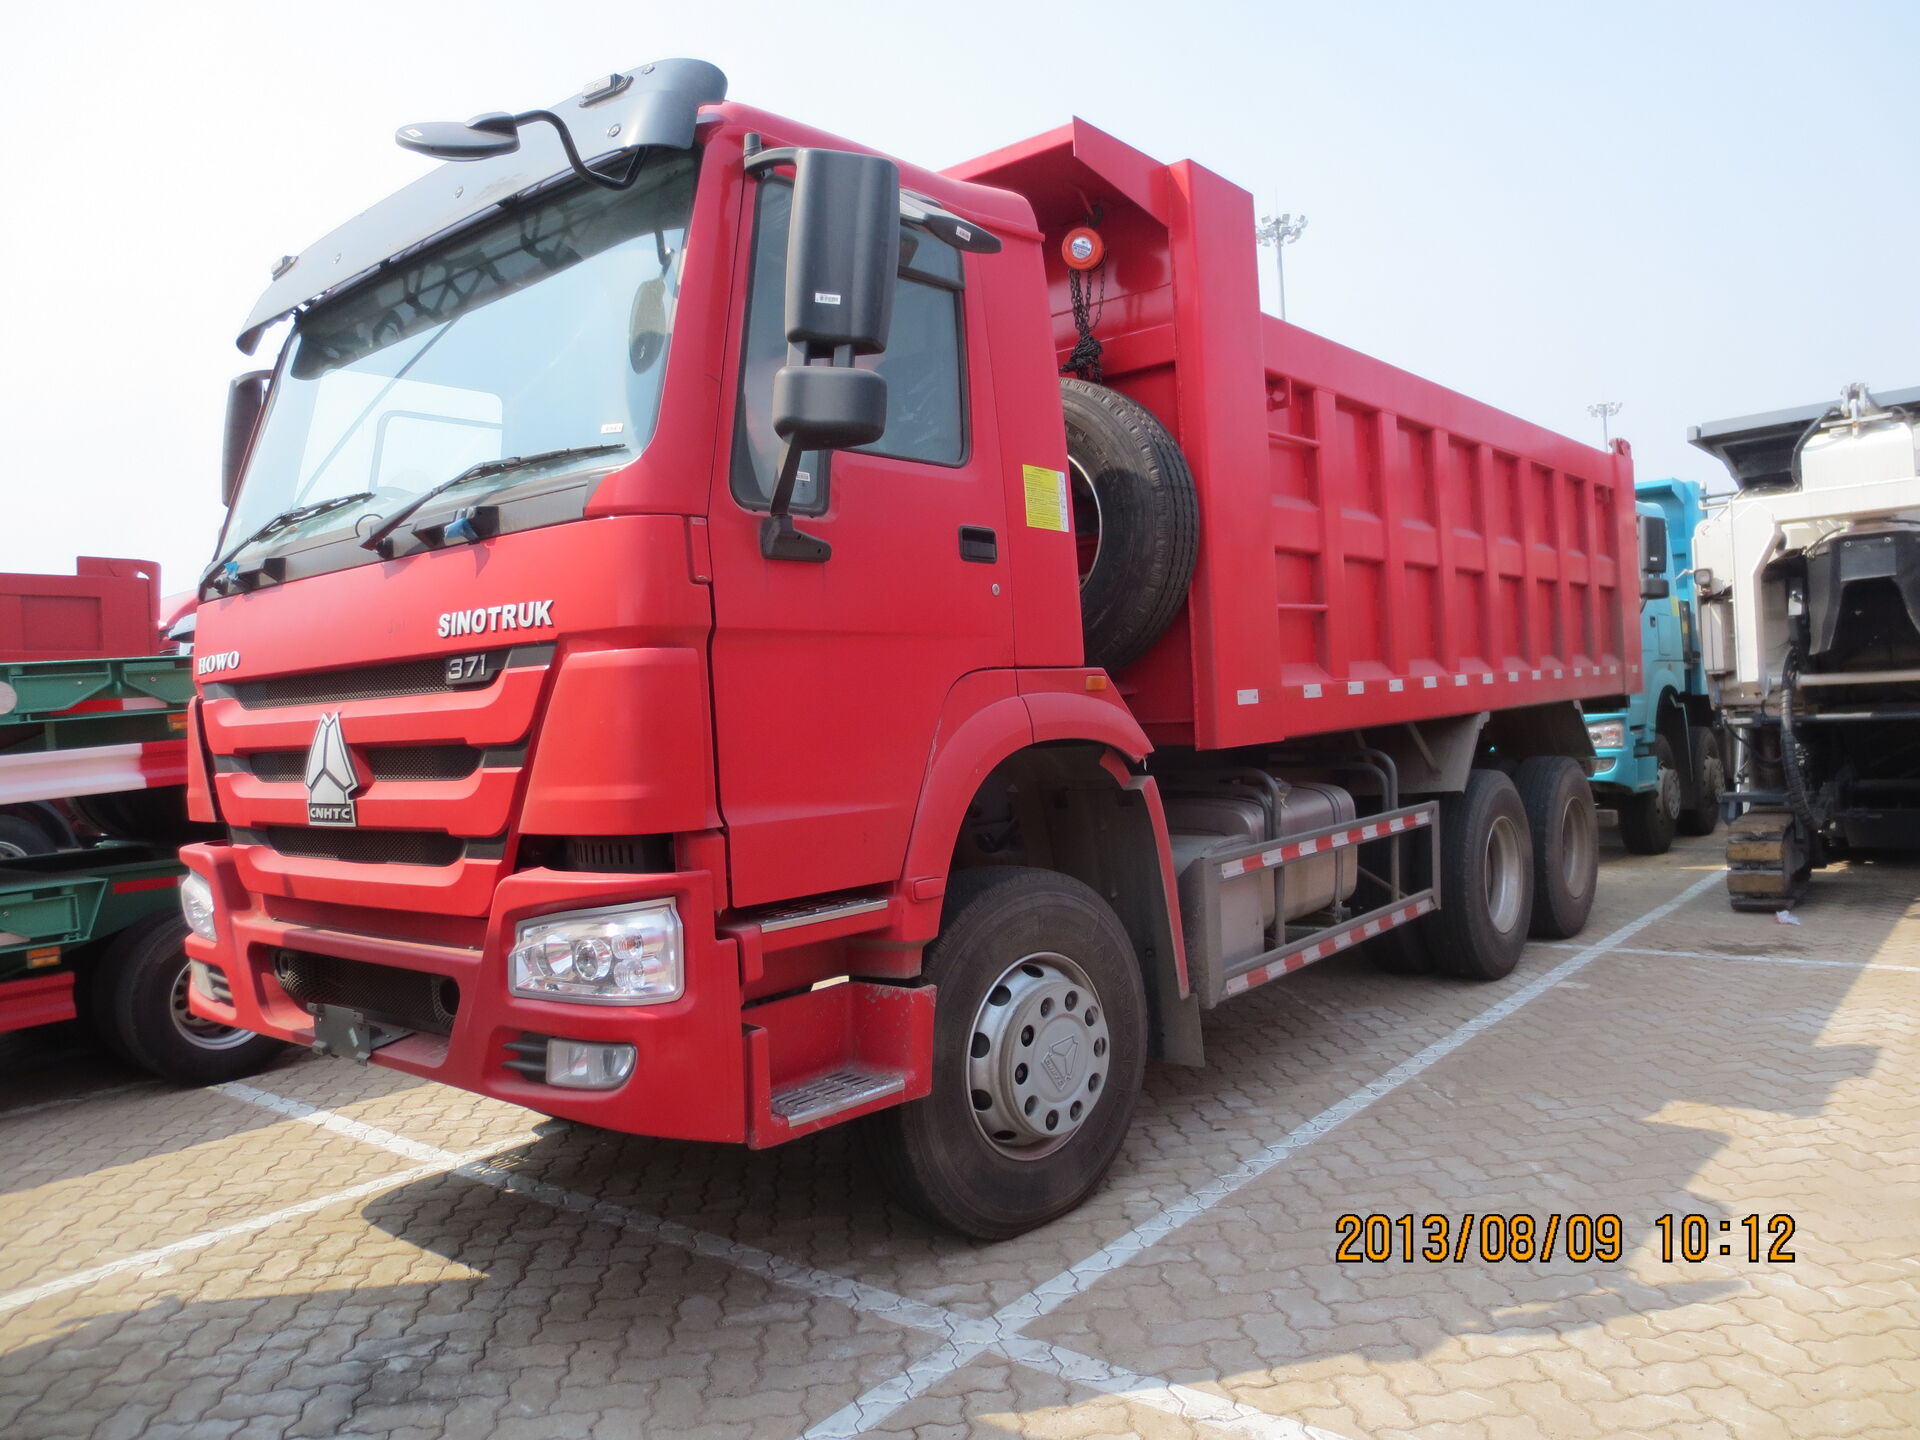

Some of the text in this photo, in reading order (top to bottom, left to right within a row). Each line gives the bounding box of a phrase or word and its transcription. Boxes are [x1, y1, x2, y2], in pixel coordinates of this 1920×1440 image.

[437, 600, 553, 637] SINOTRUK
[198, 650, 240, 675] HOWO
[448, 653, 486, 680] 371
[310, 807, 351, 819] CNHTC
